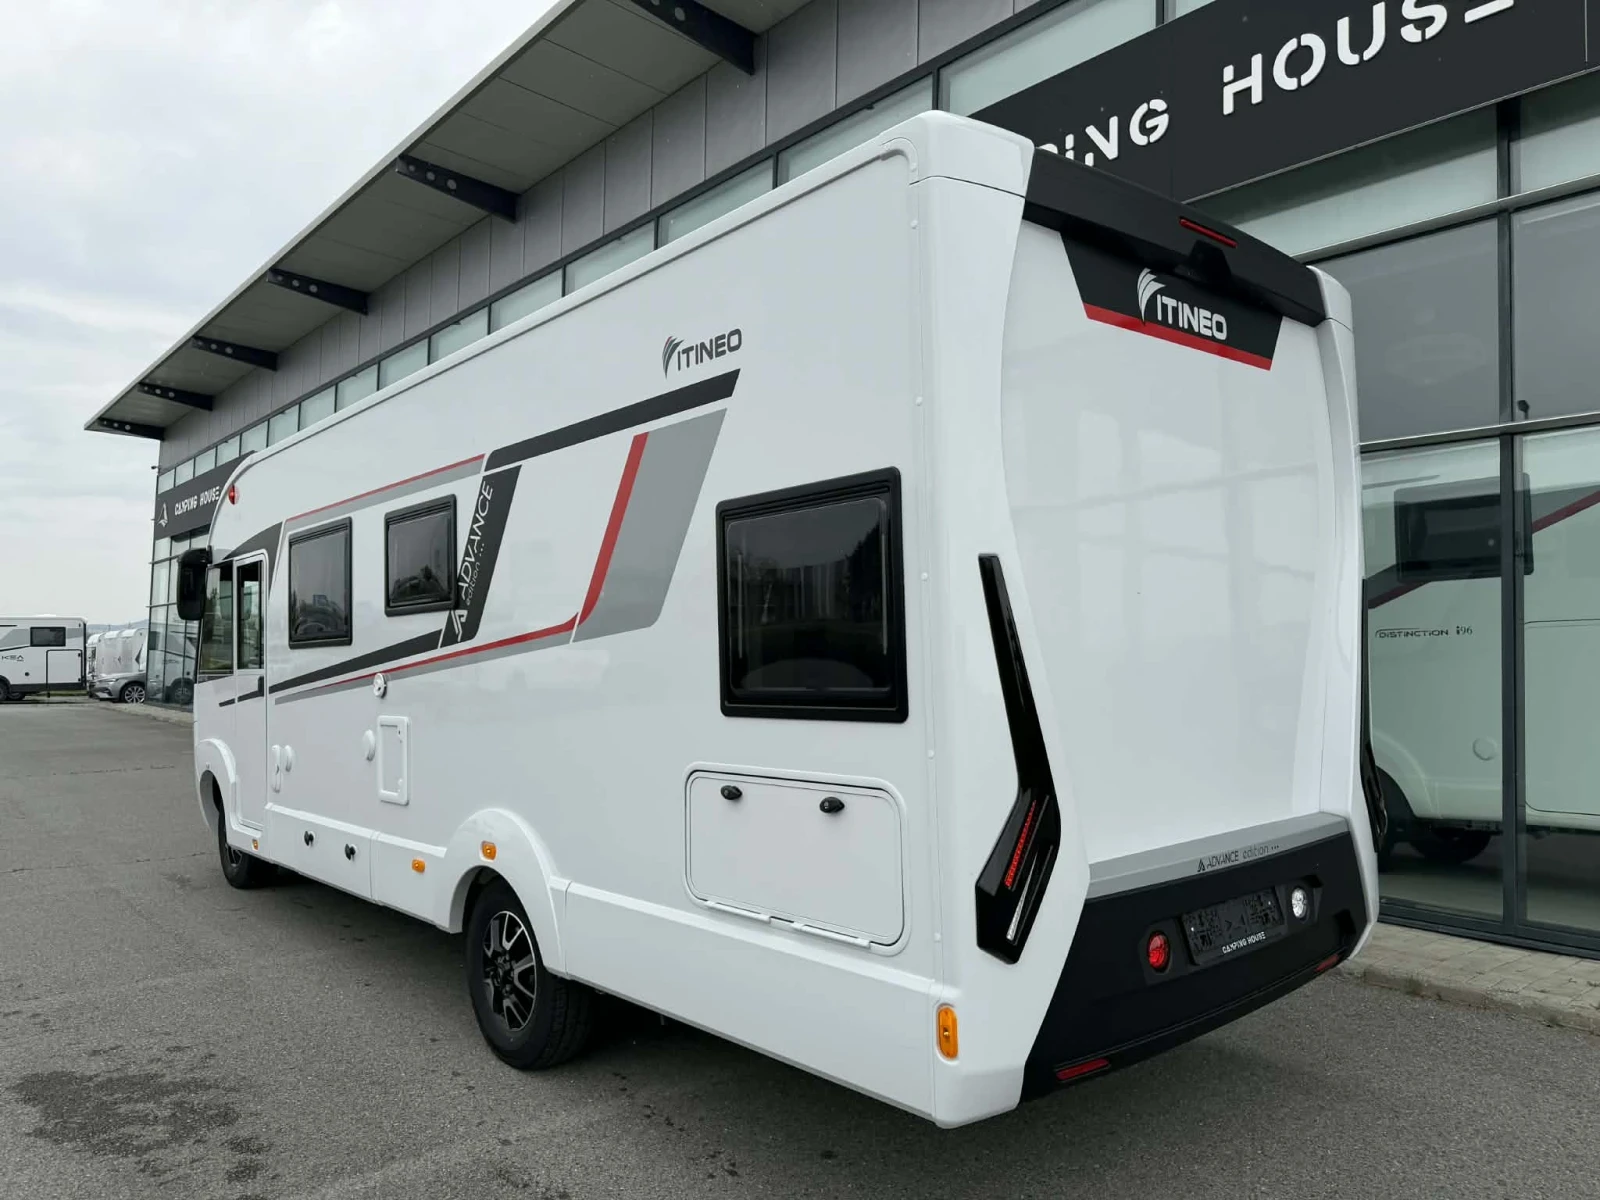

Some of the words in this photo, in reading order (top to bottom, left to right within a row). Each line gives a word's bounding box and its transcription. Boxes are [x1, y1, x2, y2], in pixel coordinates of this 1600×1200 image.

[1037, 98, 1170, 167] ING
[1156, 293, 1228, 341] ITINEO
[677, 328, 742, 371] ITINEO
[174, 495, 198, 516] CAMPING
[199, 485, 220, 507] HOUSE
[458, 481, 494, 600] ADVANCE
[466, 561, 481, 606] edition
[1206, 850, 1239, 869] ADVANCE
[1221, 937, 1248, 954] CAMPING
[1247, 931, 1267, 945] HOUSE
